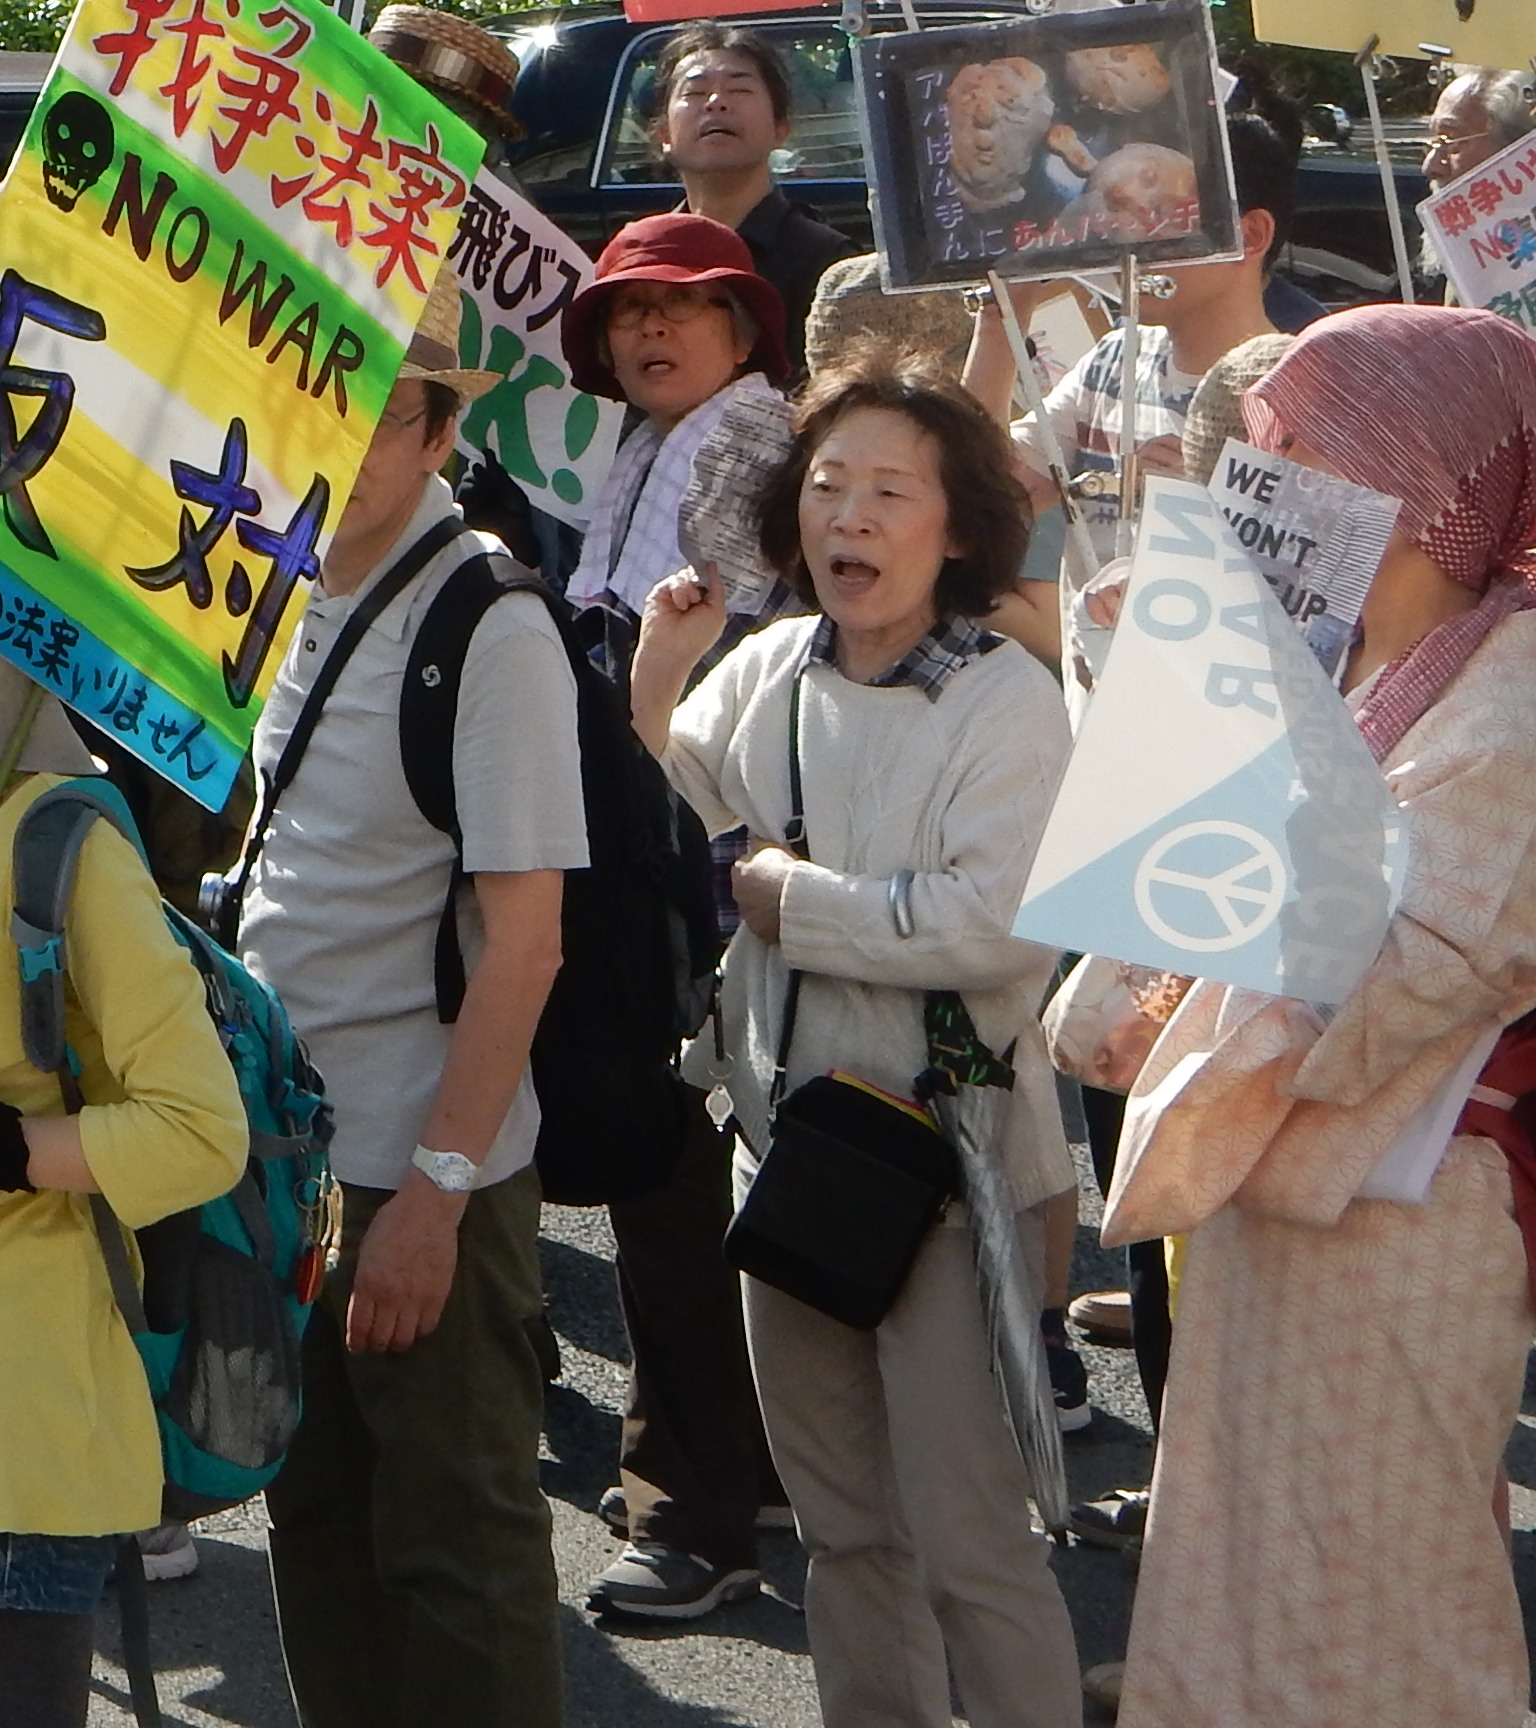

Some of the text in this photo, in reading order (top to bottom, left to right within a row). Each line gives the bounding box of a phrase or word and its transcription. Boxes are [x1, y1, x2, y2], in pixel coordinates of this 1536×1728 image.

[102, 153, 365, 418] NO WAR
[1226, 456, 1281, 504] WE
